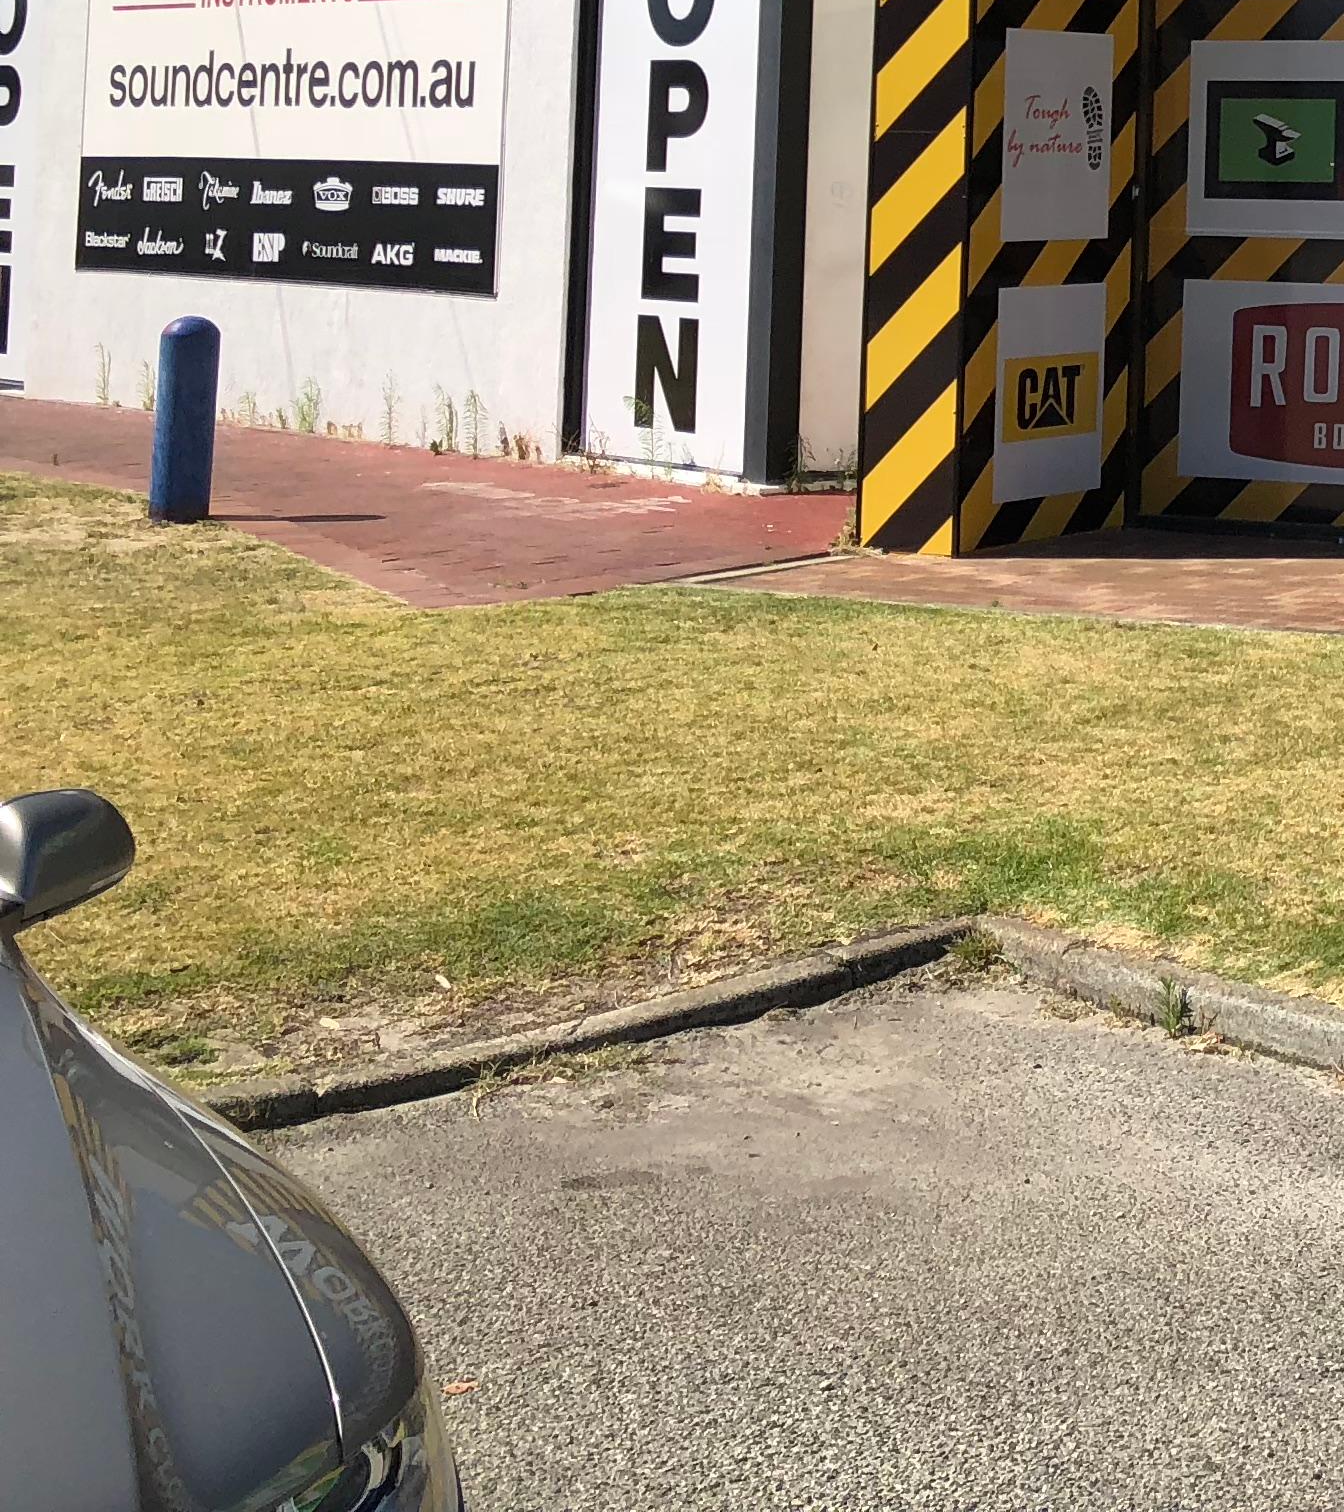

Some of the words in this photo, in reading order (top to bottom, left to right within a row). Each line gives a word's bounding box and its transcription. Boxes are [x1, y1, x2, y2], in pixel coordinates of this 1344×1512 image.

[109, 47, 476, 109] soundcentre.com.au
[1024, 93, 1071, 127] Tough
[1007, 130, 1026, 168] by
[1030, 133, 1083, 155] nature
[88, 169, 133, 207] Fender
[143, 176, 184, 203] GRETSCH
[250, 180, 293, 204] Ibanez
[318, 189, 346, 201] VOX
[381, 186, 419, 206] BOSS
[436, 187, 485, 207] SHURE
[253, 232, 286, 263] ESP
[371, 242, 414, 266] AKG
[1017, 364, 1082, 430] CAT
